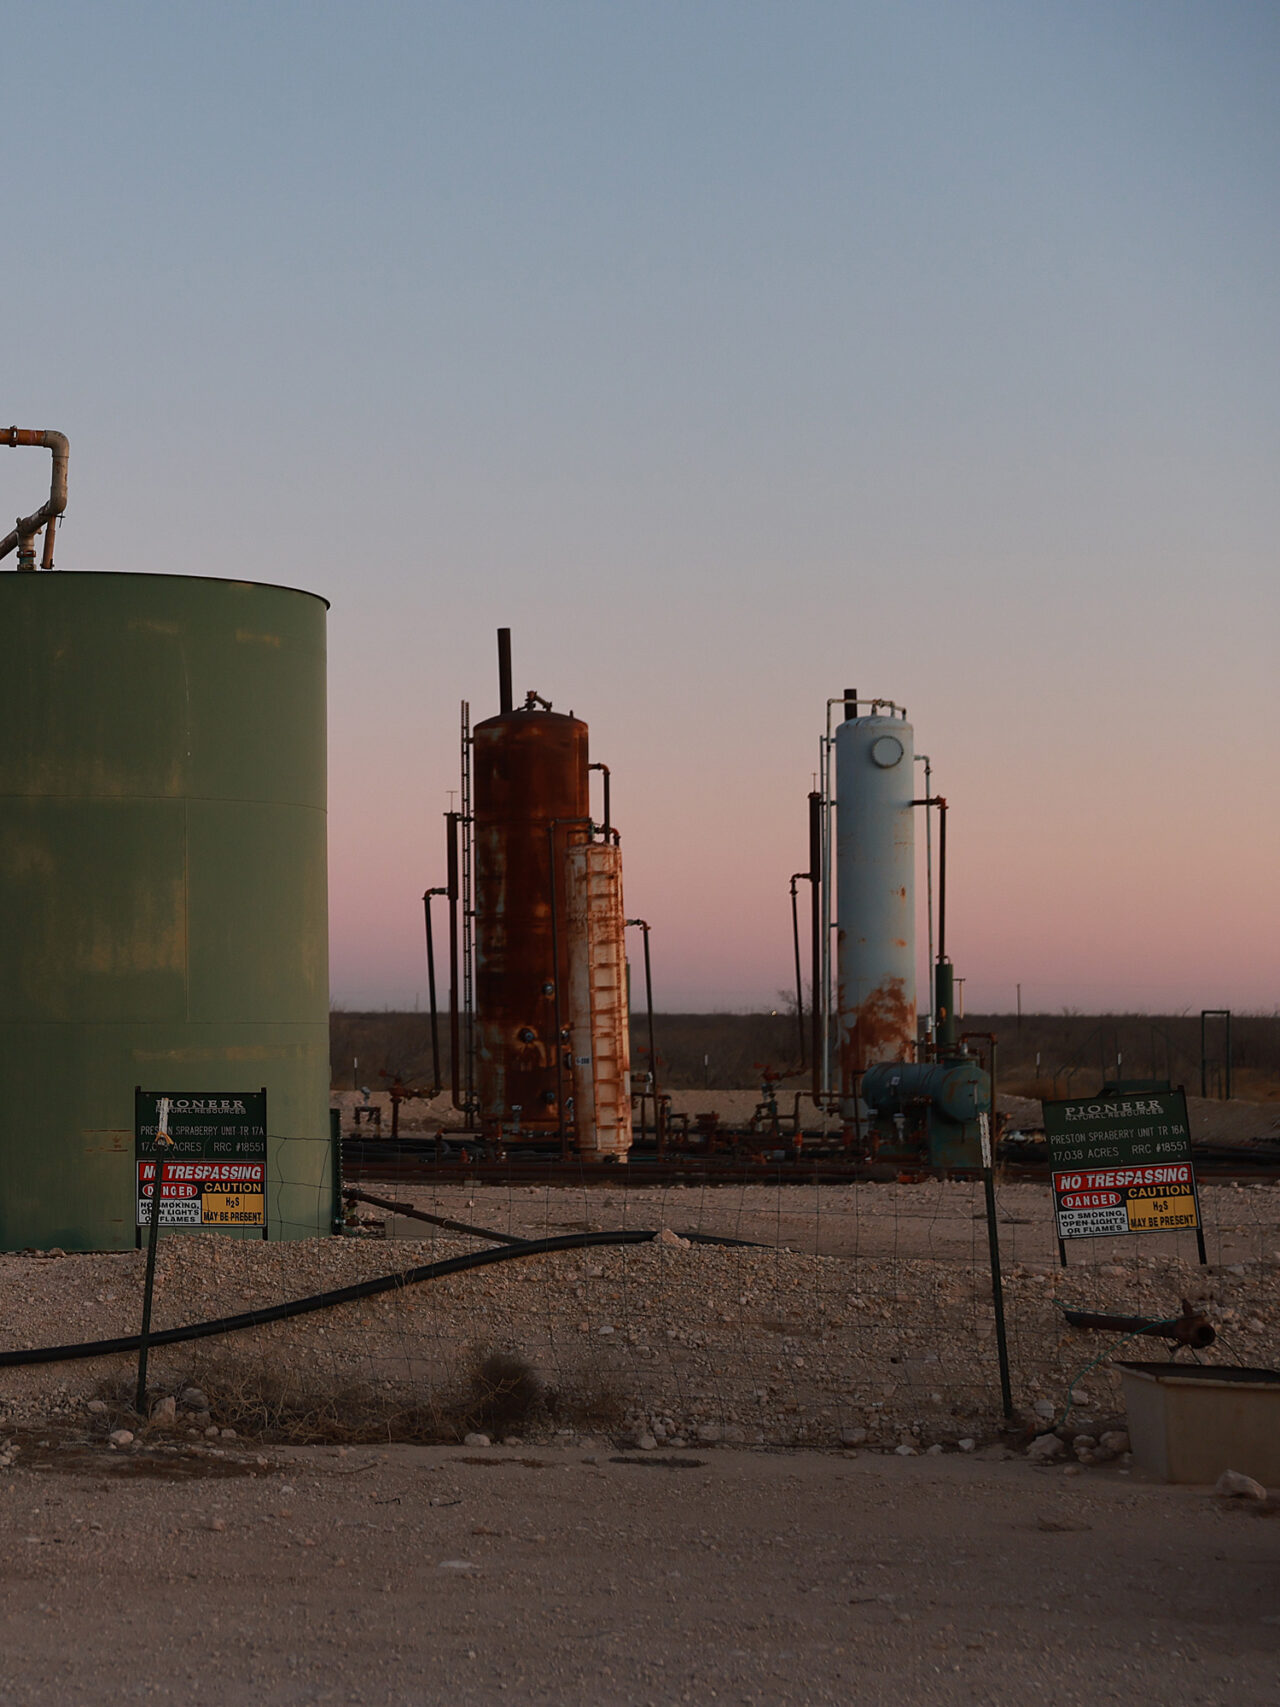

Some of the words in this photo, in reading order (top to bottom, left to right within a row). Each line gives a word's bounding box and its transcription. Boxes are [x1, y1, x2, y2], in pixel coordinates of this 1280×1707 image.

[155, 1106, 193, 1115] NTURAL
[1064, 1099, 1161, 1116] PIONEER
[140, 1125, 173, 1136] PRESN
[175, 1125, 218, 1136] SPRABERRY
[221, 1125, 236, 1136] UNIT
[240, 1125, 249, 1136] TR
[252, 1125, 265, 1136] 17A
[1050, 1132, 1086, 1145] PRESTON
[1088, 1127, 1134, 1142] SPRABERRY
[1137, 1126, 1154, 1138] UNIT
[1158, 1125, 1169, 1136] TR
[172, 1140, 202, 1152] ACRES
[213, 1141, 233, 1152] RRC
[236, 1141, 265, 1152] #18551
[1053, 1150, 1084, 1161] 17,038
[1087, 1146, 1120, 1159] ACRES
[1131, 1144, 1152, 1155] RRC
[1155, 1140, 1187, 1153] #18551
[167, 1165, 262, 1180] TRESPASSING
[1060, 1174, 1082, 1190] NO
[1085, 1166, 1189, 1188] TRESPASSING
[147, 1186, 193, 1197] DNGER
[204, 1182, 261, 1193] CAUTION
[1127, 1184, 1191, 1198] CAUTION
[225, 1197, 240, 1208] H2S
[1066, 1193, 1117, 1207] DANGER
[1152, 1200, 1169, 1212] H2S
[203, 1212, 218, 1222] MAY
[220, 1212, 229, 1222] BE
[230, 1212, 261, 1222] PRESENT
[1077, 1210, 1125, 1219] SMOKING,
[1090, 1217, 1125, 1225] LIGHTS
[1130, 1217, 1146, 1228] MAY
[1148, 1217, 1158, 1226] BE
[1159, 1214, 1194, 1226] PRESENT
[1083, 1225, 1122, 1233] FLAMES
